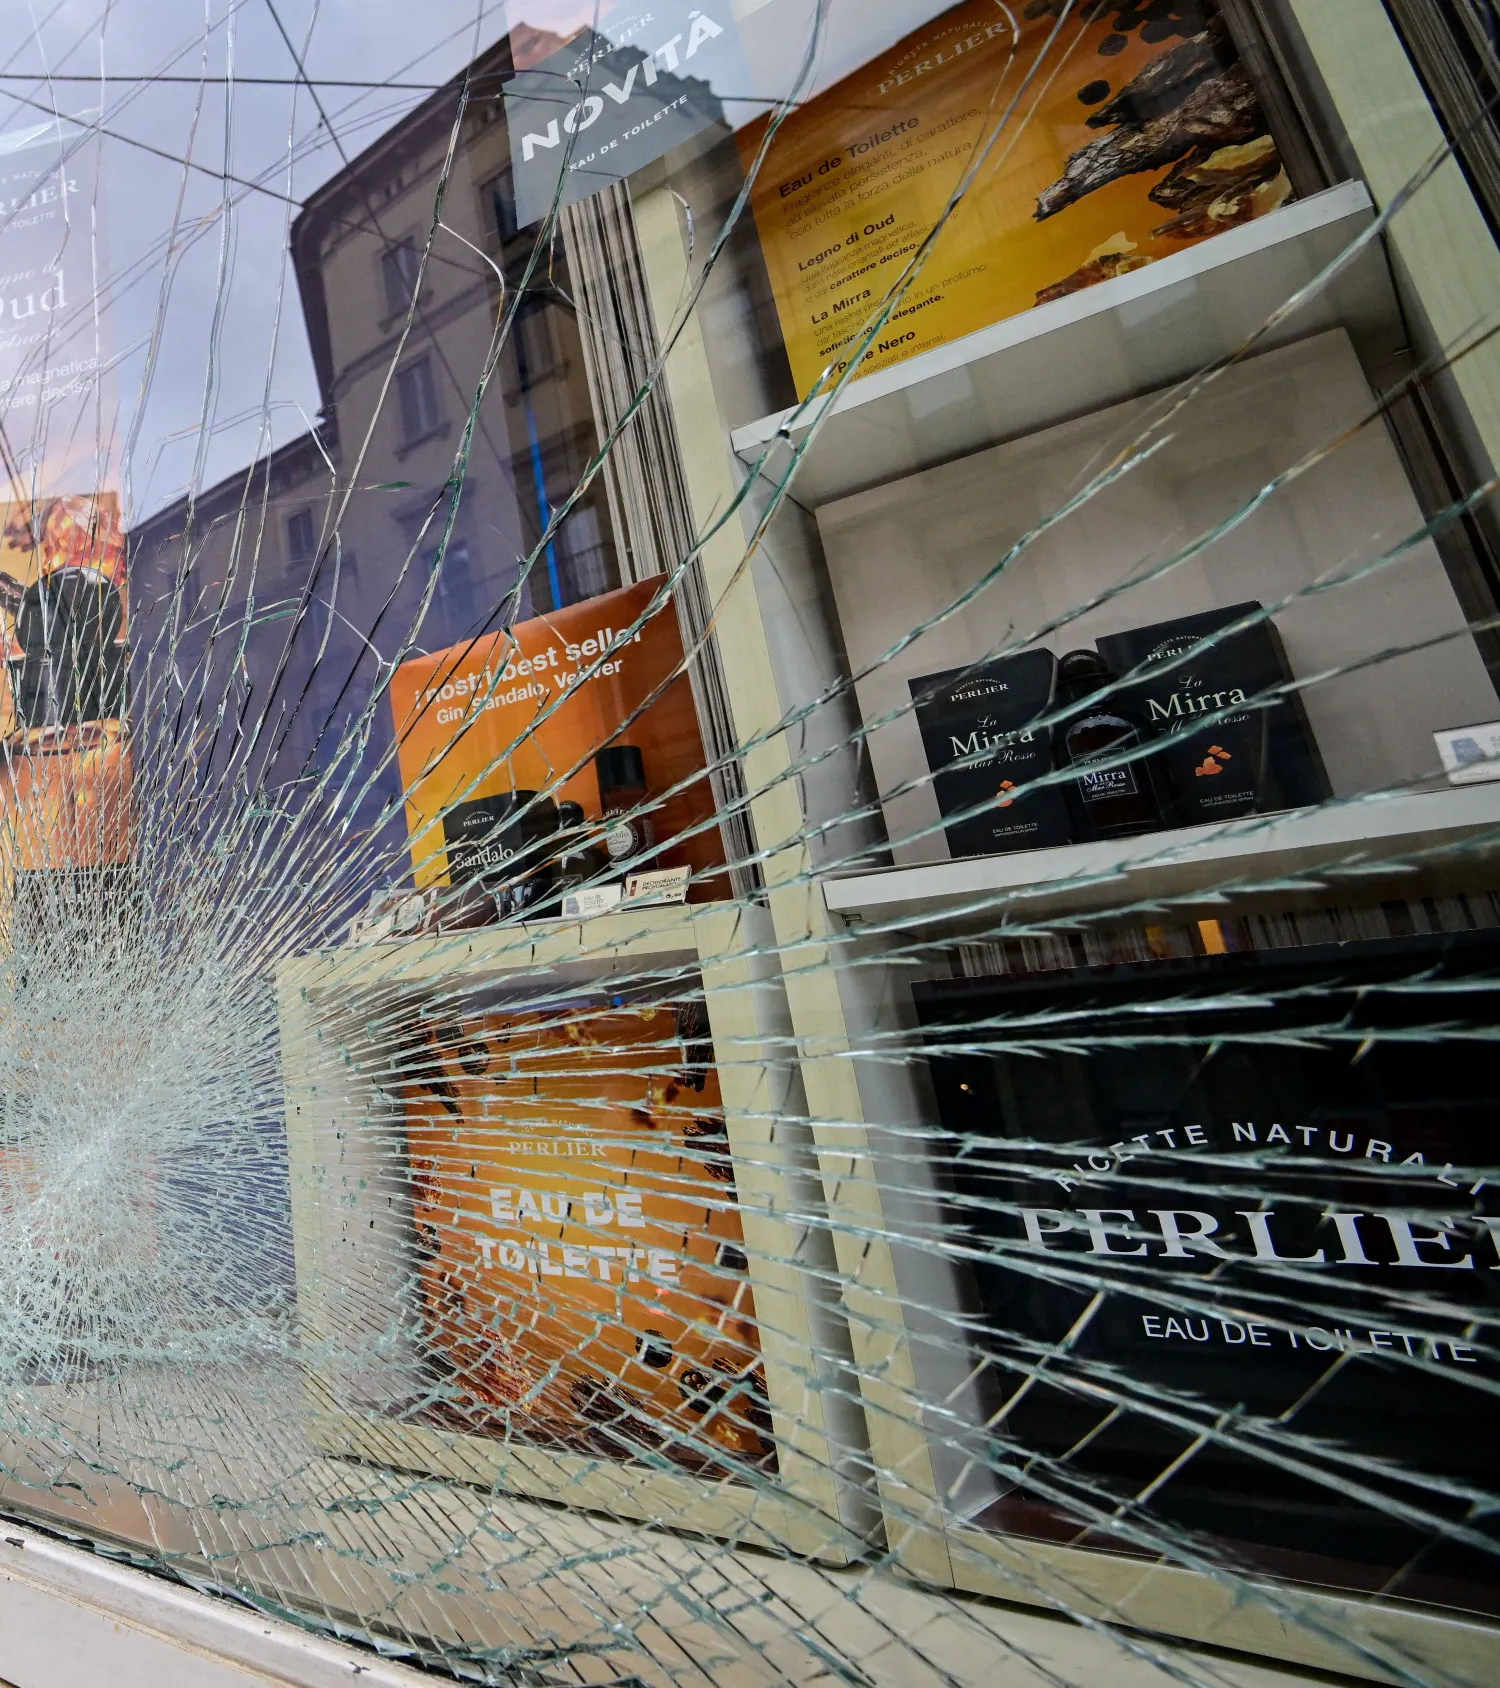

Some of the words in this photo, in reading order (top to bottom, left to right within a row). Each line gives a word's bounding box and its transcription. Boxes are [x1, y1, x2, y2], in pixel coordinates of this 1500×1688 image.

[566, 13, 654, 79] PERLIER
[877, 23, 1008, 95] PERLIER
[521, 11, 724, 162] NOVITÀ
[568, 155, 596, 173] EAU
[600, 140, 619, 155] DE
[622, 94, 688, 141] TOILETTE
[901, 136, 913, 150] di
[779, 172, 813, 199] Eau
[818, 157, 842, 175] de
[845, 116, 919, 159] Toilette
[786, 212, 801, 227] ad
[805, 188, 846, 217] elevata
[790, 223, 812, 239] con
[815, 206, 841, 226] tutta
[844, 197, 855, 208] la
[858, 182, 894, 201] forza
[893, 164, 924, 185] della
[798, 243, 841, 271] Legno
[846, 231, 859, 245] di
[863, 214, 895, 235] Oud
[830, 262, 876, 290] carattere
[880, 243, 919, 264] deciso.
[942, 264, 986, 288] profumo
[812, 310, 828, 324] La
[832, 289, 871, 313] Mirra
[892, 295, 944, 321] elegante.
[838, 351, 874, 374] Ppe
[878, 331, 916, 353] Nero
[414, 690, 422, 709] i
[426, 664, 492, 702] nostri
[501, 647, 558, 683] best
[951, 684, 1009, 701] PERLIER
[1179, 674, 1202, 689] La
[977, 714, 997, 728] La
[1146, 688, 1247, 721] Mirra
[949, 729, 1036, 757] Mirra
[998, 750, 1036, 764] Rosso
[1084, 771, 1126, 785] Mirra
[463, 816, 495, 826] PERLIER
[455, 843, 514, 869] Sandalo
[507, 1141, 607, 1157] PERLIER
[1055, 1124, 1207, 1193] RICETTE
[1232, 1121, 1487, 1195] NATURALI
[490, 1188, 569, 1224] EAU
[584, 1192, 646, 1228] DE
[1016, 1208, 1500, 1271] PERLIE
[474, 1238, 680, 1284] TOILETTE
[1141, 1315, 1209, 1342] EAU
[1221, 1321, 1272, 1347] DE
[1286, 1327, 1477, 1362] TOILETTE
